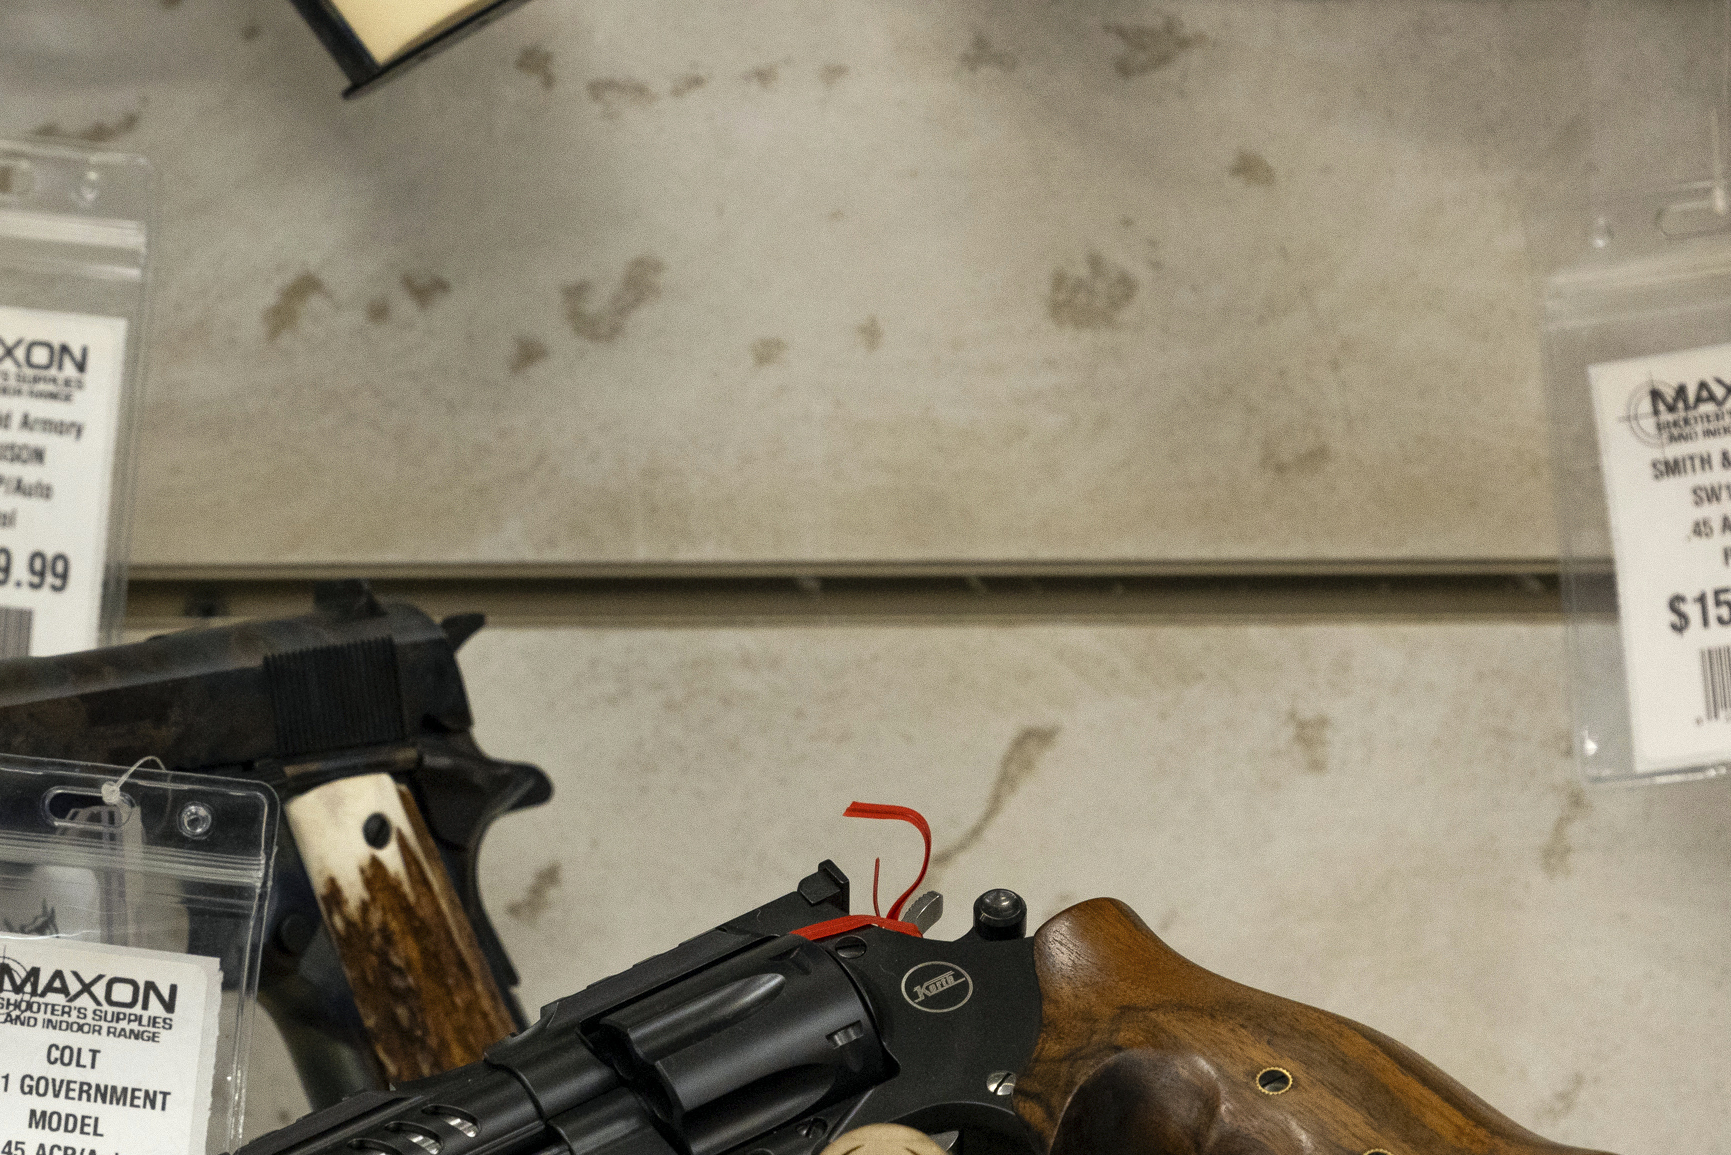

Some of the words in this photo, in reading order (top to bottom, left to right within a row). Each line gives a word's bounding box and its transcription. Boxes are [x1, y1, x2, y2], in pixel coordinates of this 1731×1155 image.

[20, 411, 85, 442] Armory
[1651, 451, 1713, 481] SMITH
[3, 1013, 38, 1028] AND
[42, 1018, 102, 1036] INDOOR
[106, 1025, 161, 1043] RANGE
[91, 1009, 173, 1031] SUPPLIES
[46, 1043, 101, 1070] COLT
[20, 1073, 172, 1111] GOVERNMENT
[27, 1108, 104, 1137] MODEL
